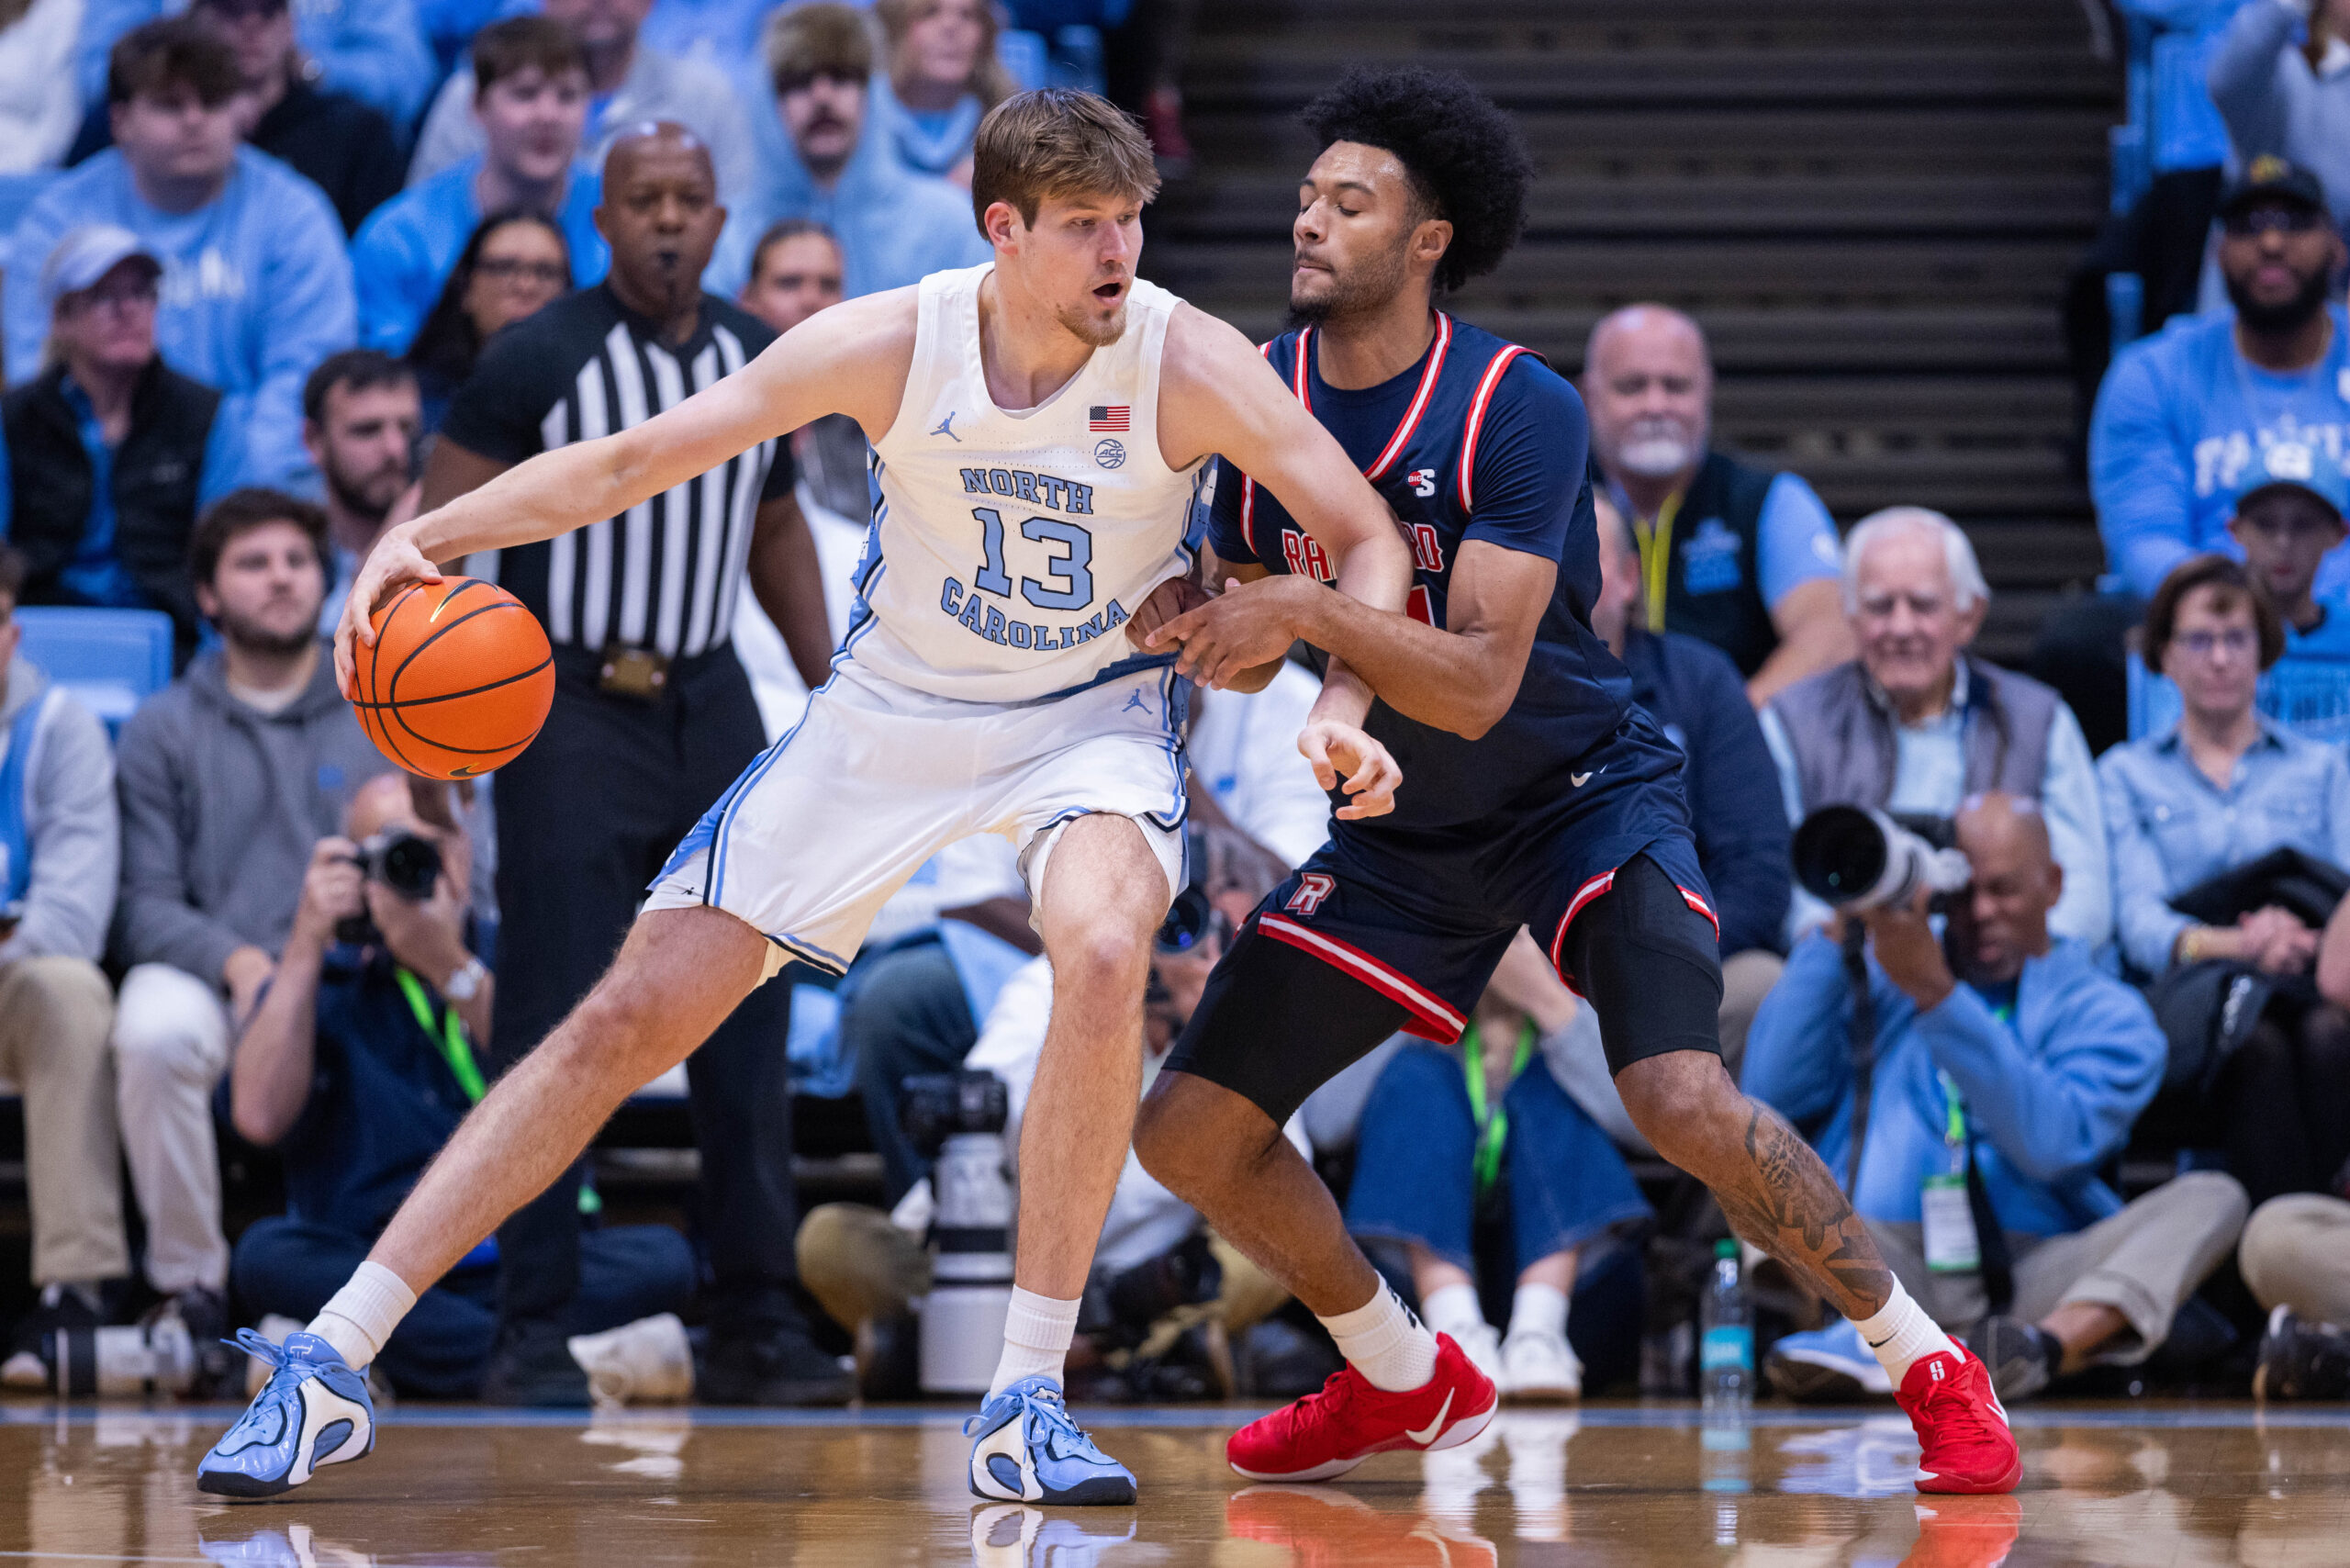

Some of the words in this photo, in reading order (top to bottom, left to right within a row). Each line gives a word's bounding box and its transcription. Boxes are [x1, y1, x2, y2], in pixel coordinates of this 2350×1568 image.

[1099, 448, 1124, 456] ACC
[960, 468, 1093, 514] NORTH
[972, 507, 1093, 610] 13
[940, 577, 1130, 650] CAROLINA
